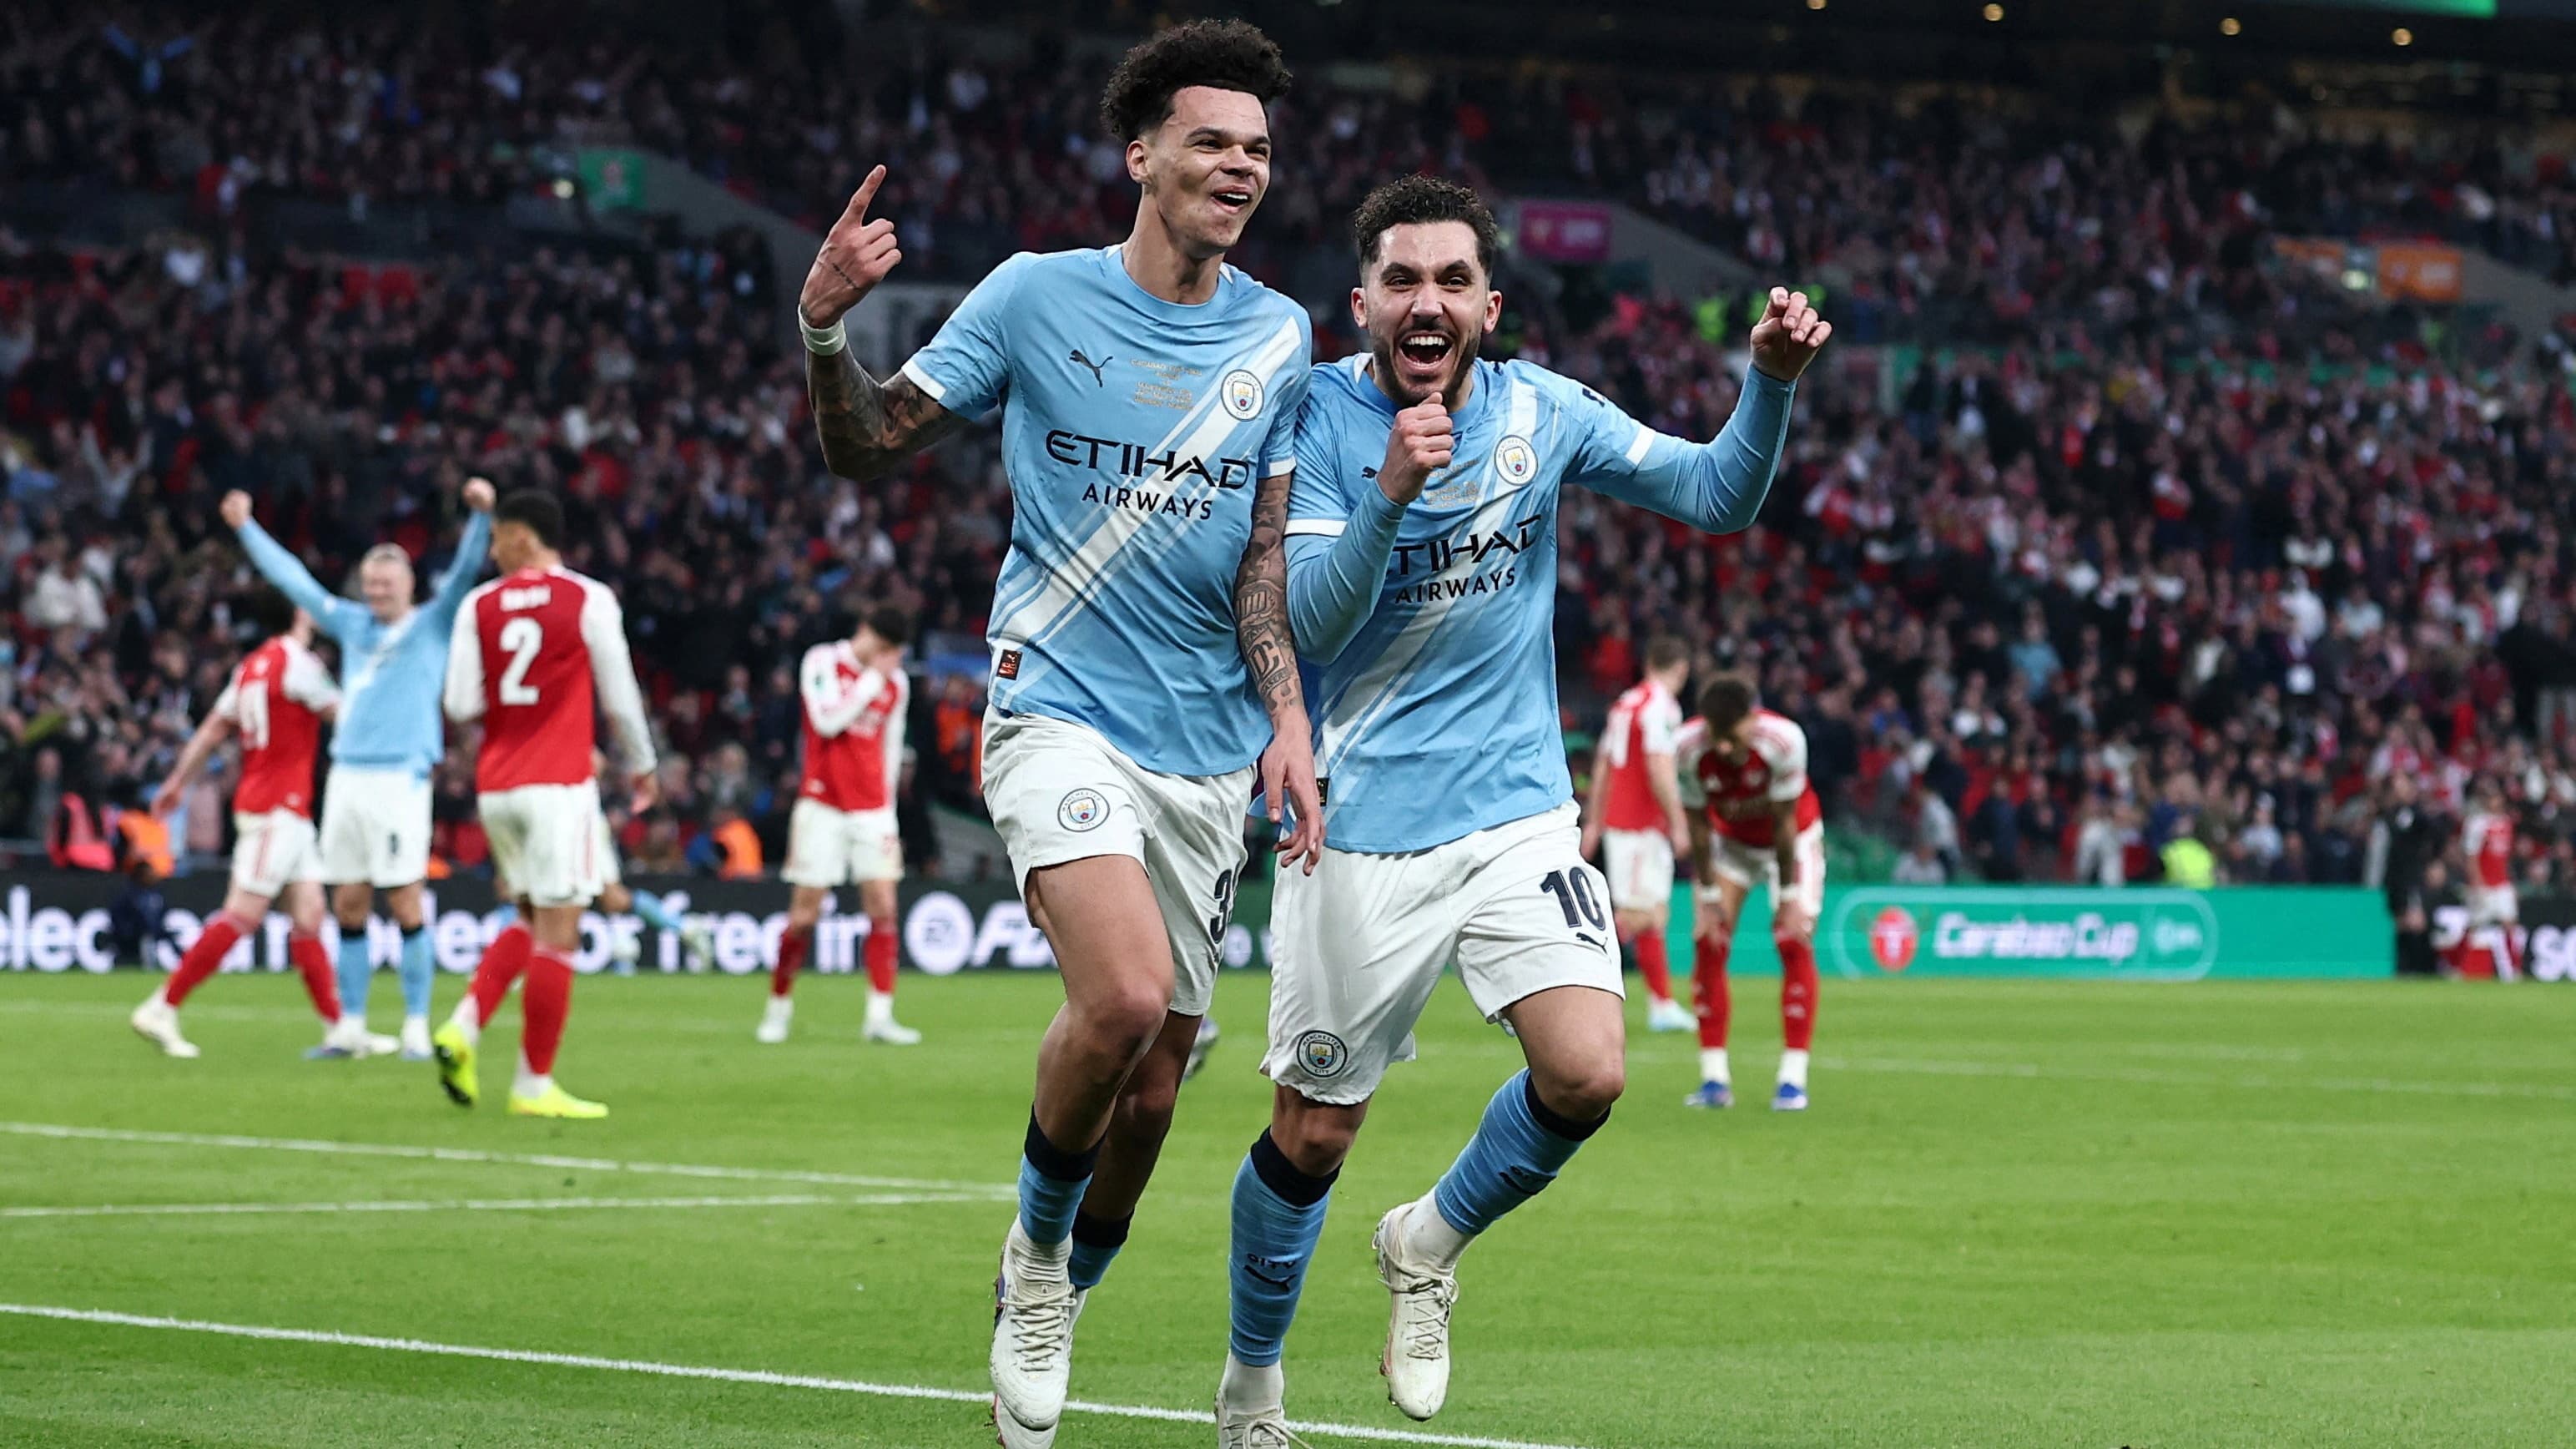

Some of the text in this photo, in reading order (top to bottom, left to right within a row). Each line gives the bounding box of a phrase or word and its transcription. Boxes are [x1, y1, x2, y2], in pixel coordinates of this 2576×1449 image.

[1046, 429, 1250, 490] ETIHAD
[1081, 482, 1212, 520] AIRWAYS
[1388, 514, 1542, 576] TIHAD
[1394, 567, 1515, 604] AIRWAYS
[500, 617, 543, 705] 2
[1209, 868, 1238, 945] 3
[1539, 866, 1606, 932] 10
[1302, 1034, 1341, 1049] MANCHESTER
